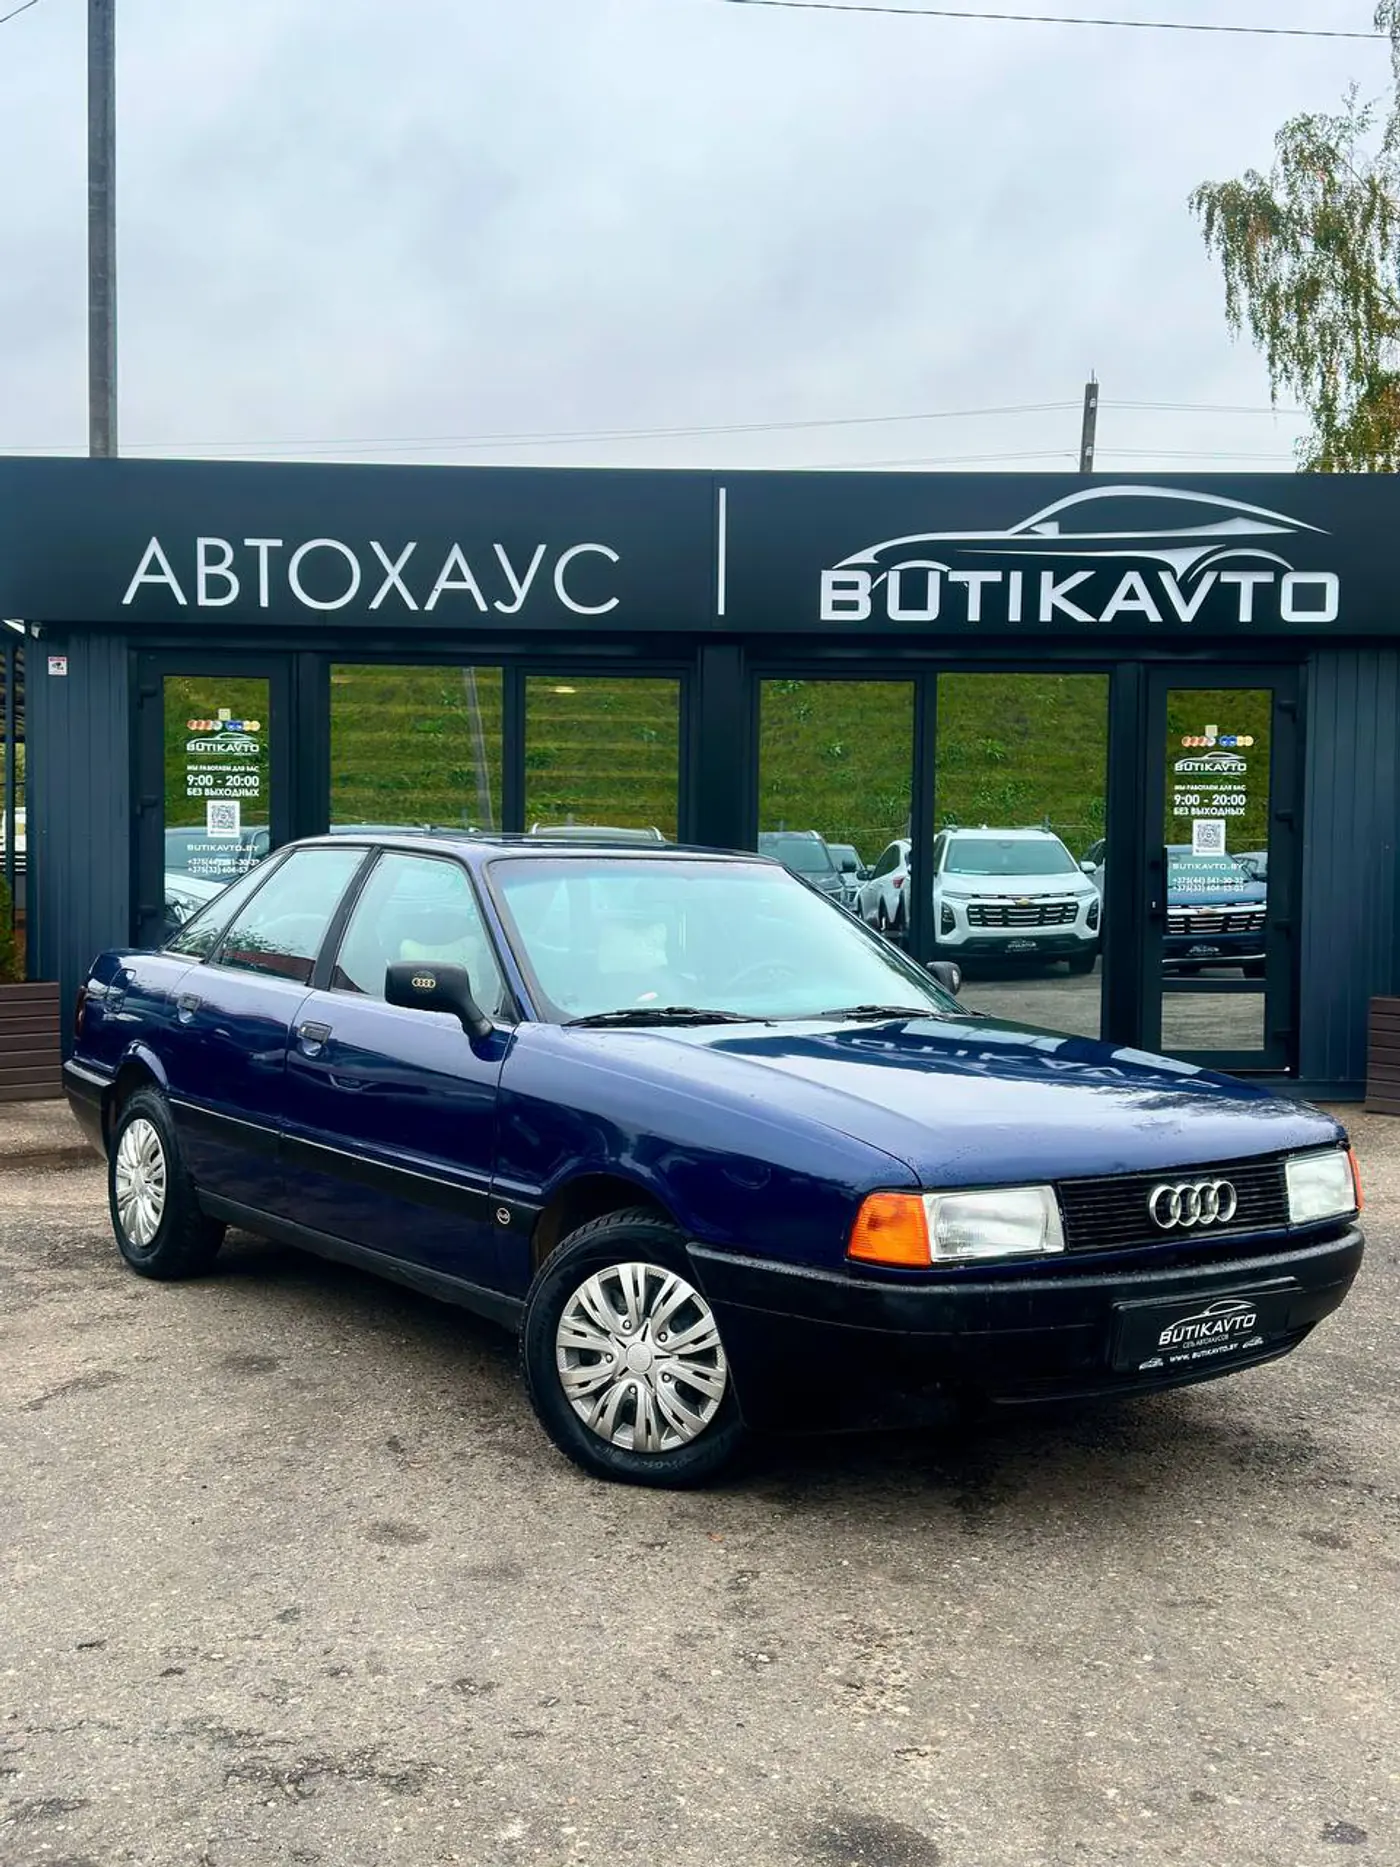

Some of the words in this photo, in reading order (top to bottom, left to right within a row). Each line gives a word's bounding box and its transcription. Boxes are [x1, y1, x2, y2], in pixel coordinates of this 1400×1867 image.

[122, 537, 620, 615] АВТОХАУС
[820, 569, 1340, 624] BUTIKAVTO
[186, 742, 260, 752] BUTIKAVTO
[1174, 761, 1247, 771] BUTIKAVTO
[186, 774, 213, 786] 9:00
[225, 775, 260, 787] 20:00
[186, 787, 203, 796] БЕЗ
[204, 787, 260, 798] ВЫХОДНЫХ
[1174, 794, 1200, 806] 9:00
[1212, 794, 1246, 806] 20:00
[1173, 806, 1189, 815] БЕЗ
[1190, 807, 1246, 816] ВЫХОДНЫХ
[186, 844, 260, 852] BUTIKAVTO.BY
[1172, 863, 1245, 871] BUTIKAVTO.BY
[1158, 1313, 1257, 1346] BUTIKAVTO
